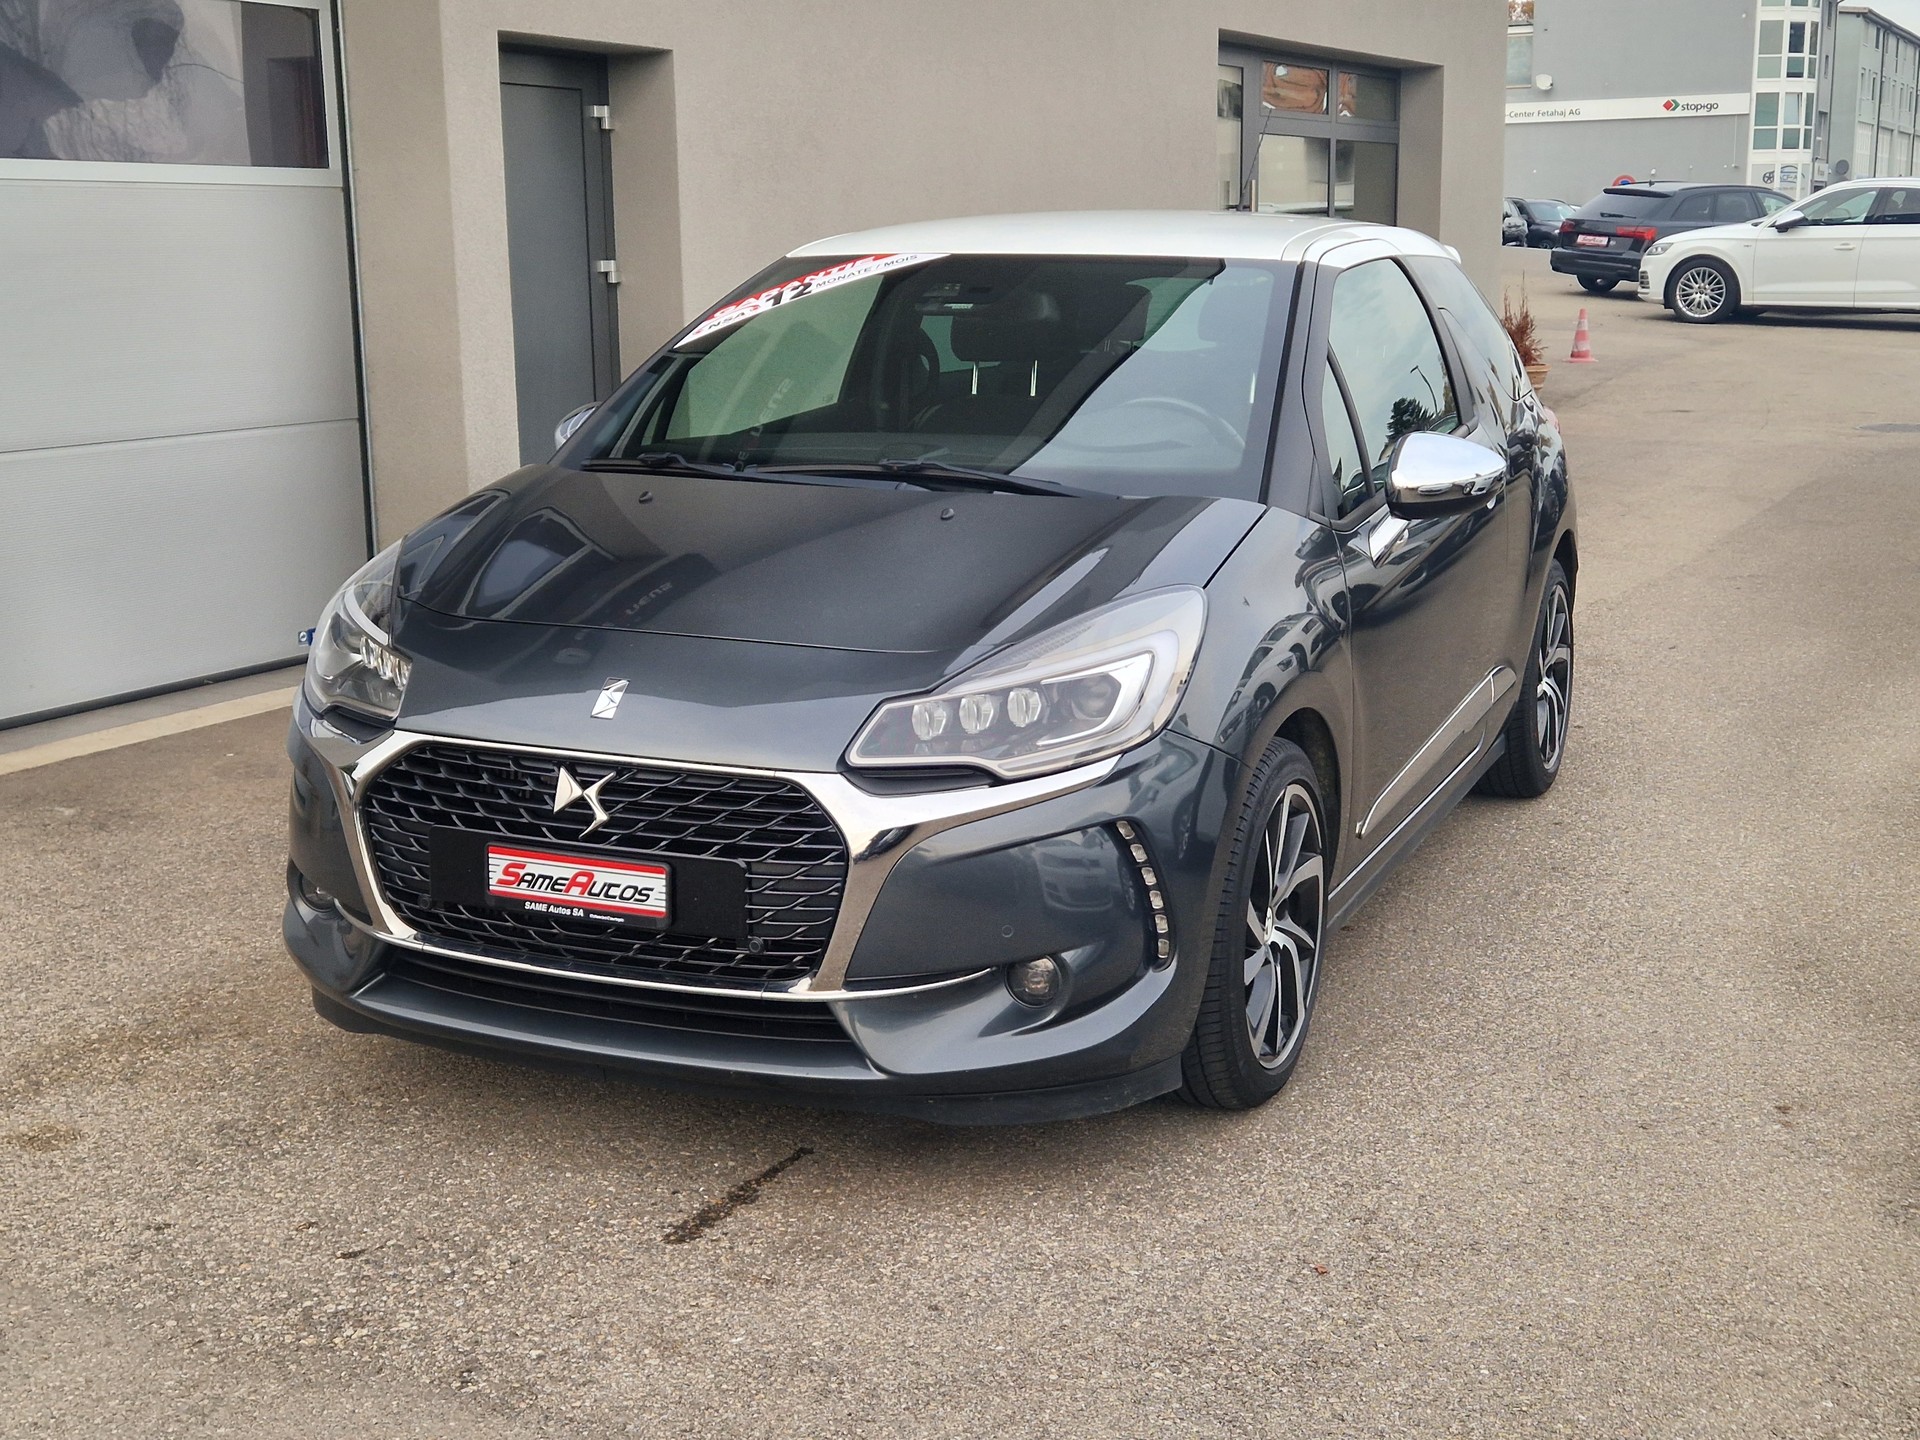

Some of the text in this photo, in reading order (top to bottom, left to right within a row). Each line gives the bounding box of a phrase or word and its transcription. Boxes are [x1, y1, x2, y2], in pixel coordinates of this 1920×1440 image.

[1568, 107, 1581, 116] AG
[764, 281, 814, 307] 12
[815, 266, 873, 288] MONATE
[883, 254, 919, 268] MOIS
[524, 901, 585, 917] SAME Autos SA
